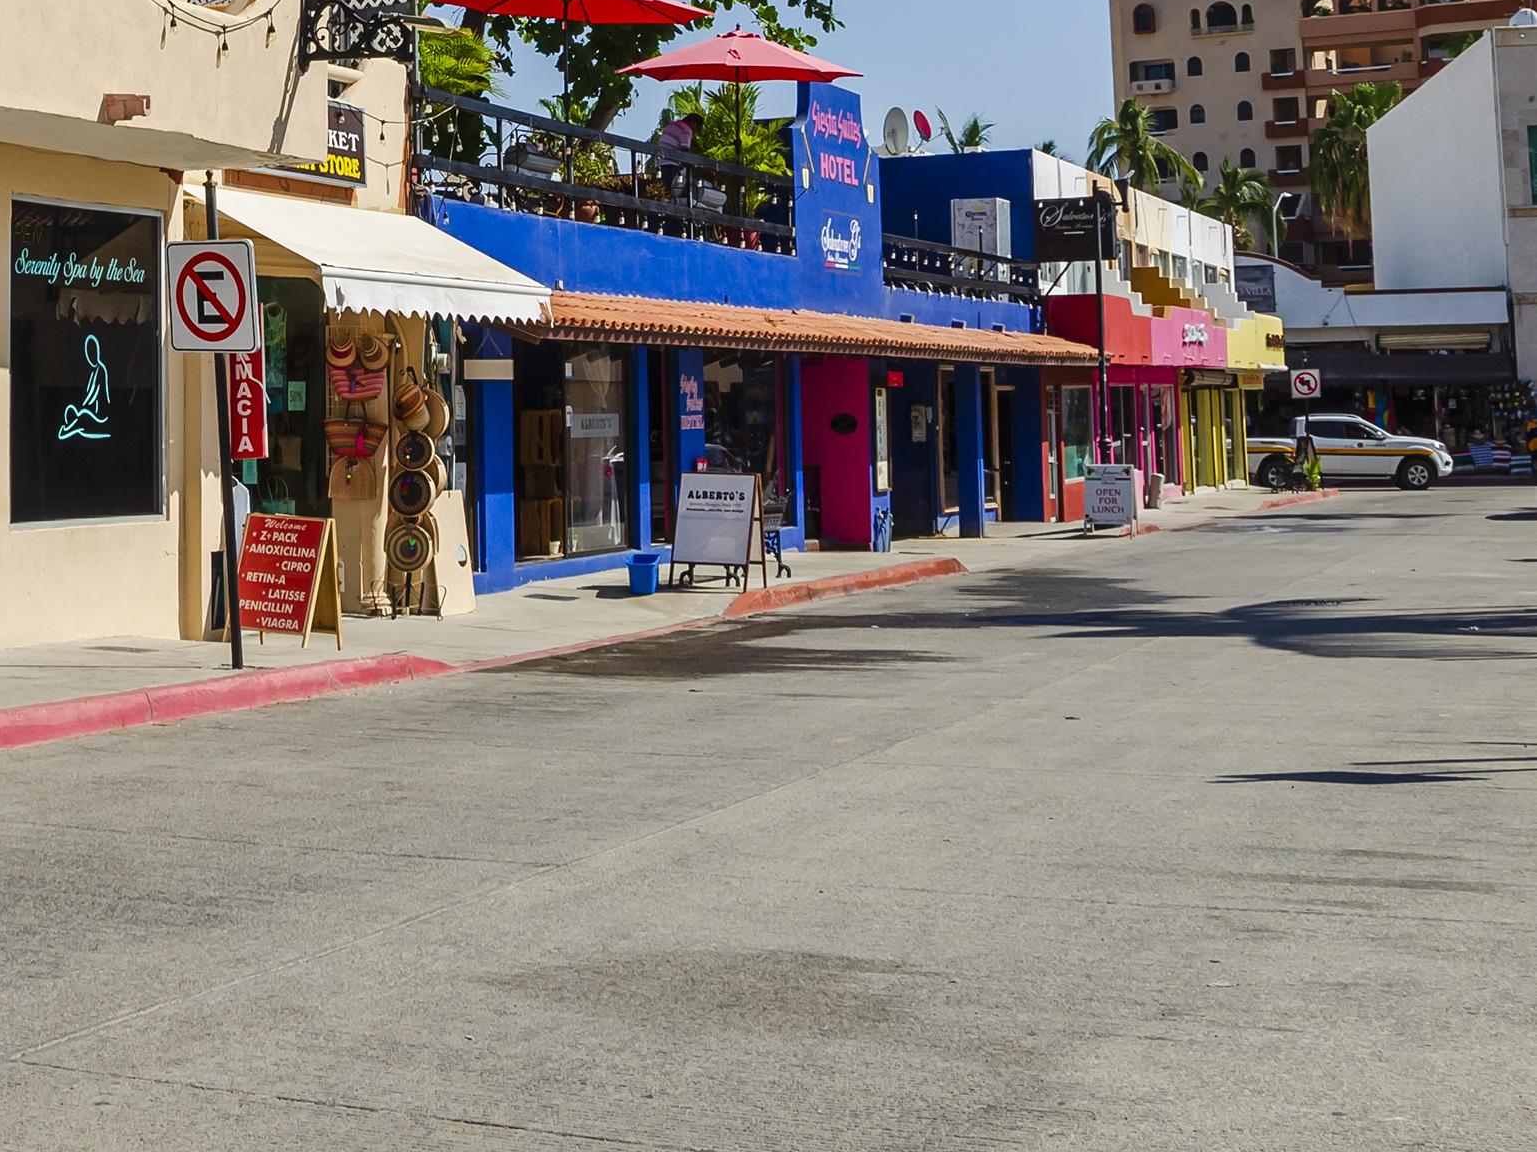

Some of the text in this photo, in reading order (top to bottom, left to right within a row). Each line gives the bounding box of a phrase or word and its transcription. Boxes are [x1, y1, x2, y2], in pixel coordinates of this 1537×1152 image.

[812, 100, 862, 149] Siesta Suites
[820, 152, 859, 187] HOTEL
[14, 248, 146, 288] Serenity Spa by the Sea
[687, 490, 745, 501] ALBERTO'S
[1095, 488, 1121, 497] OPEN
[1098, 497, 1118, 505] FOR
[1091, 505, 1125, 514] LUNCH
[264, 518, 307, 531] Welcome
[249, 543, 316, 559] AMOXICILINA
[281, 560, 311, 573] CIPRO
[246, 571, 286, 585] RETIN-A
[268, 588, 306, 602] LATISSE
[239, 599, 294, 614] PENICILLIN
[261, 616, 299, 631] VIAGRA
